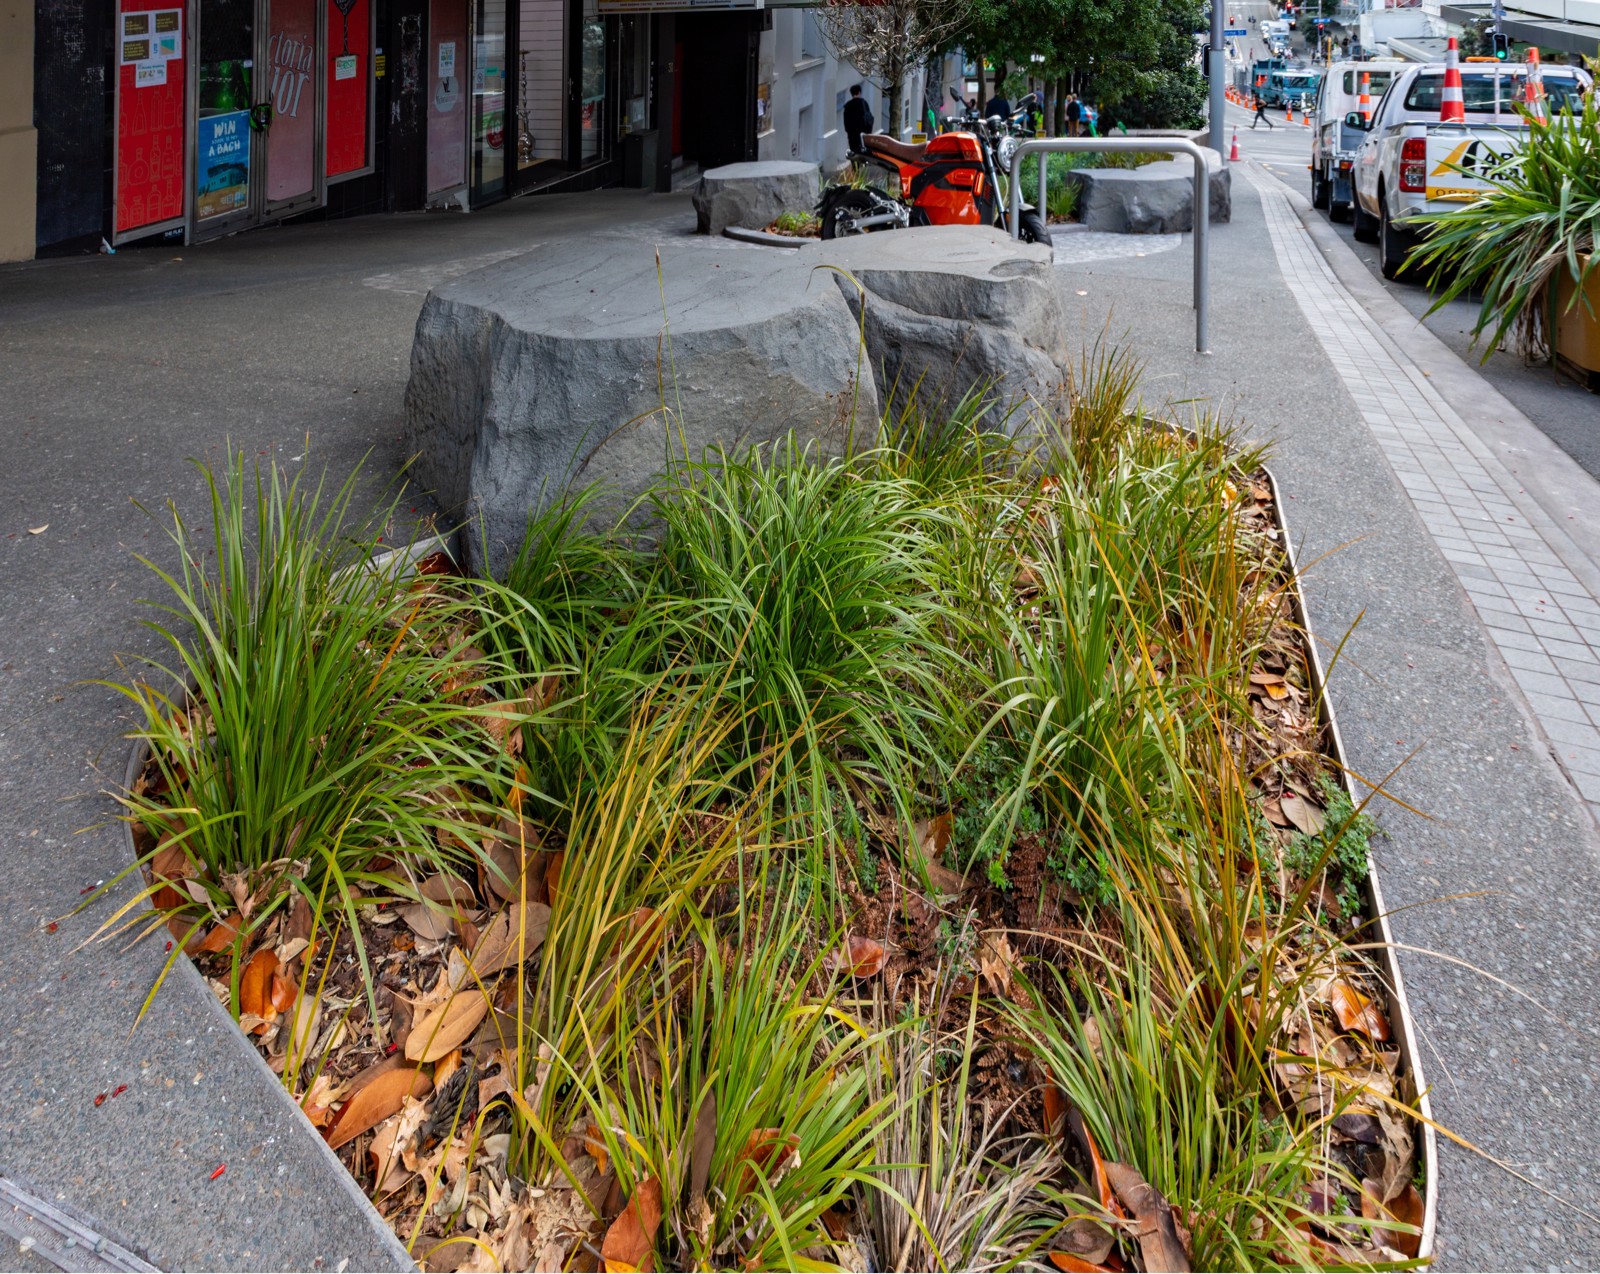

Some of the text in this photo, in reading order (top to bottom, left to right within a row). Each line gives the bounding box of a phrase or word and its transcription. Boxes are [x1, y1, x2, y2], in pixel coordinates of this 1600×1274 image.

[214, 120, 236, 139] WIN
[208, 145, 216, 157] A
[217, 139, 241, 155] BACH
